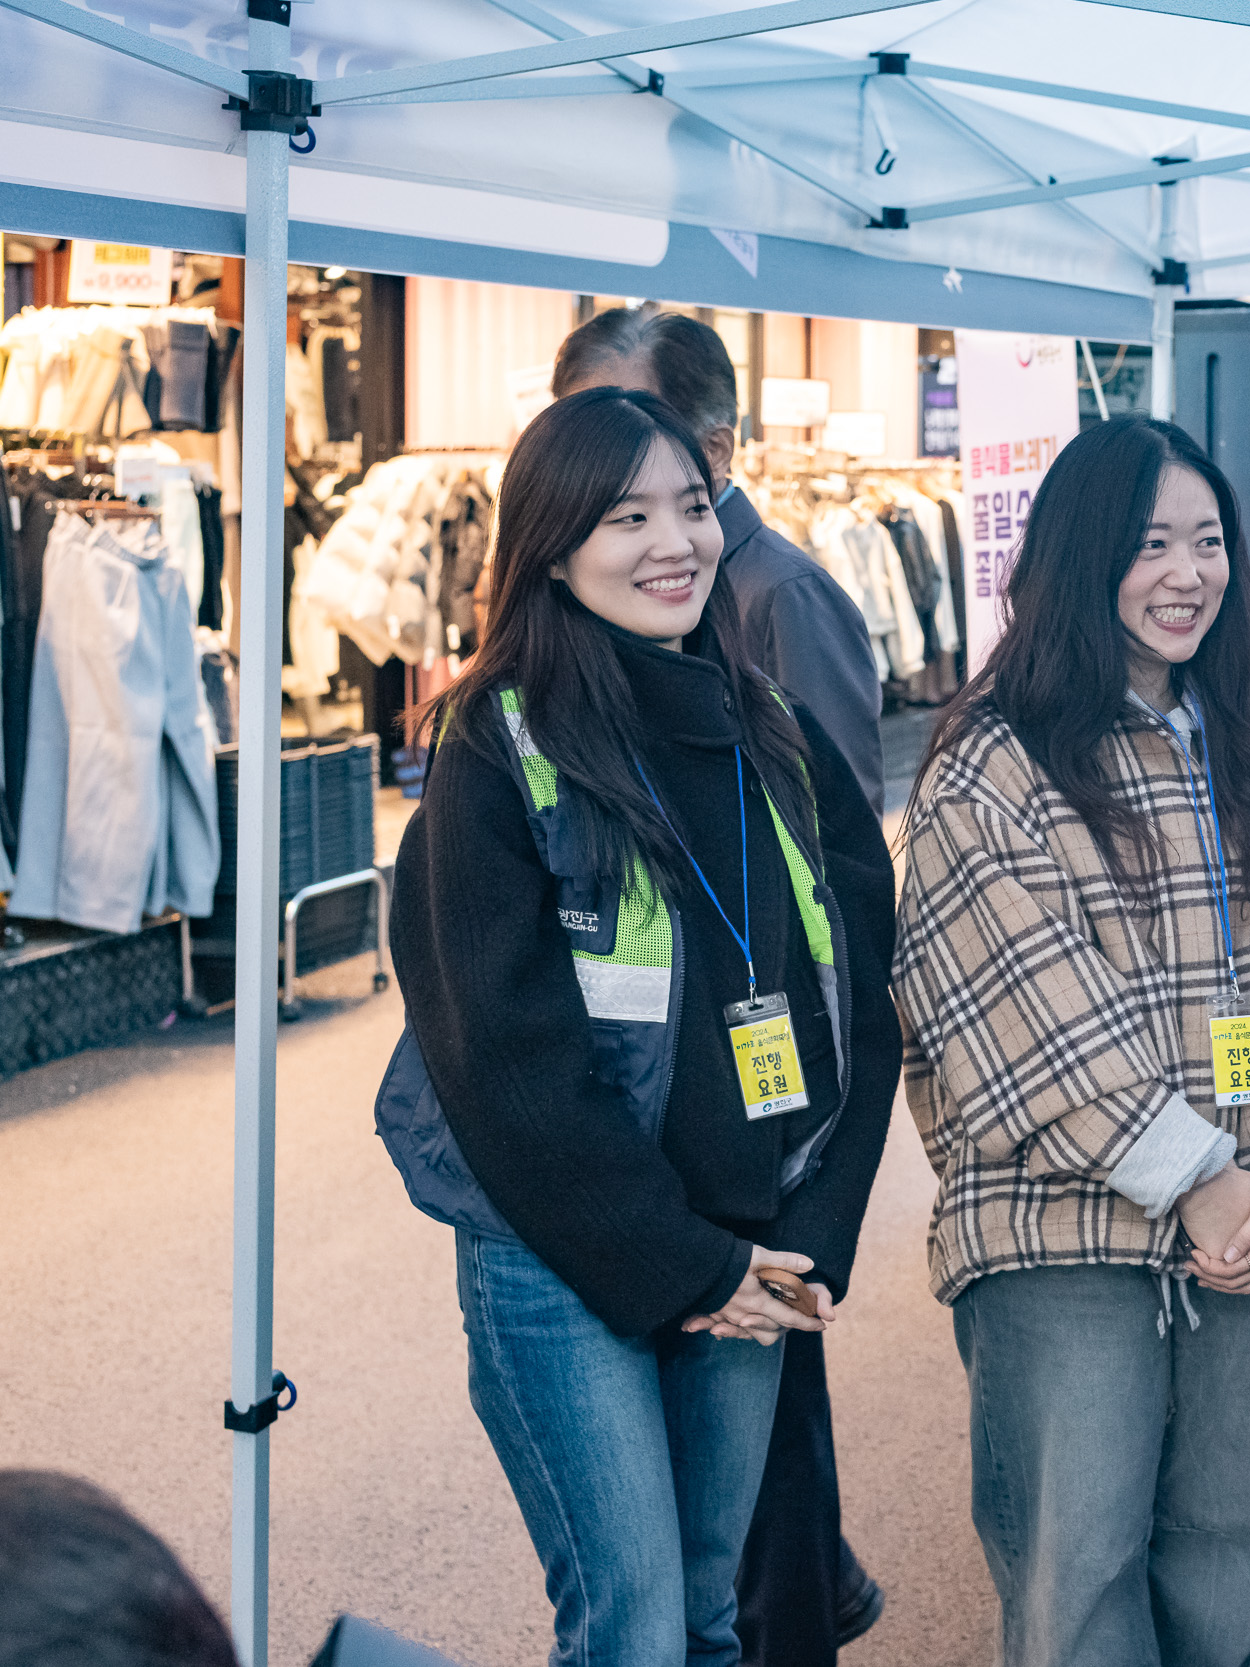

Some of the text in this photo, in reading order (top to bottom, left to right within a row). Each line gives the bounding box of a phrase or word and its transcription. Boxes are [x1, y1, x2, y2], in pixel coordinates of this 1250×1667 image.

[557, 907, 599, 925] 광진구
[751, 1051, 782, 1075] 진행
[758, 1074, 788, 1097] 요원
